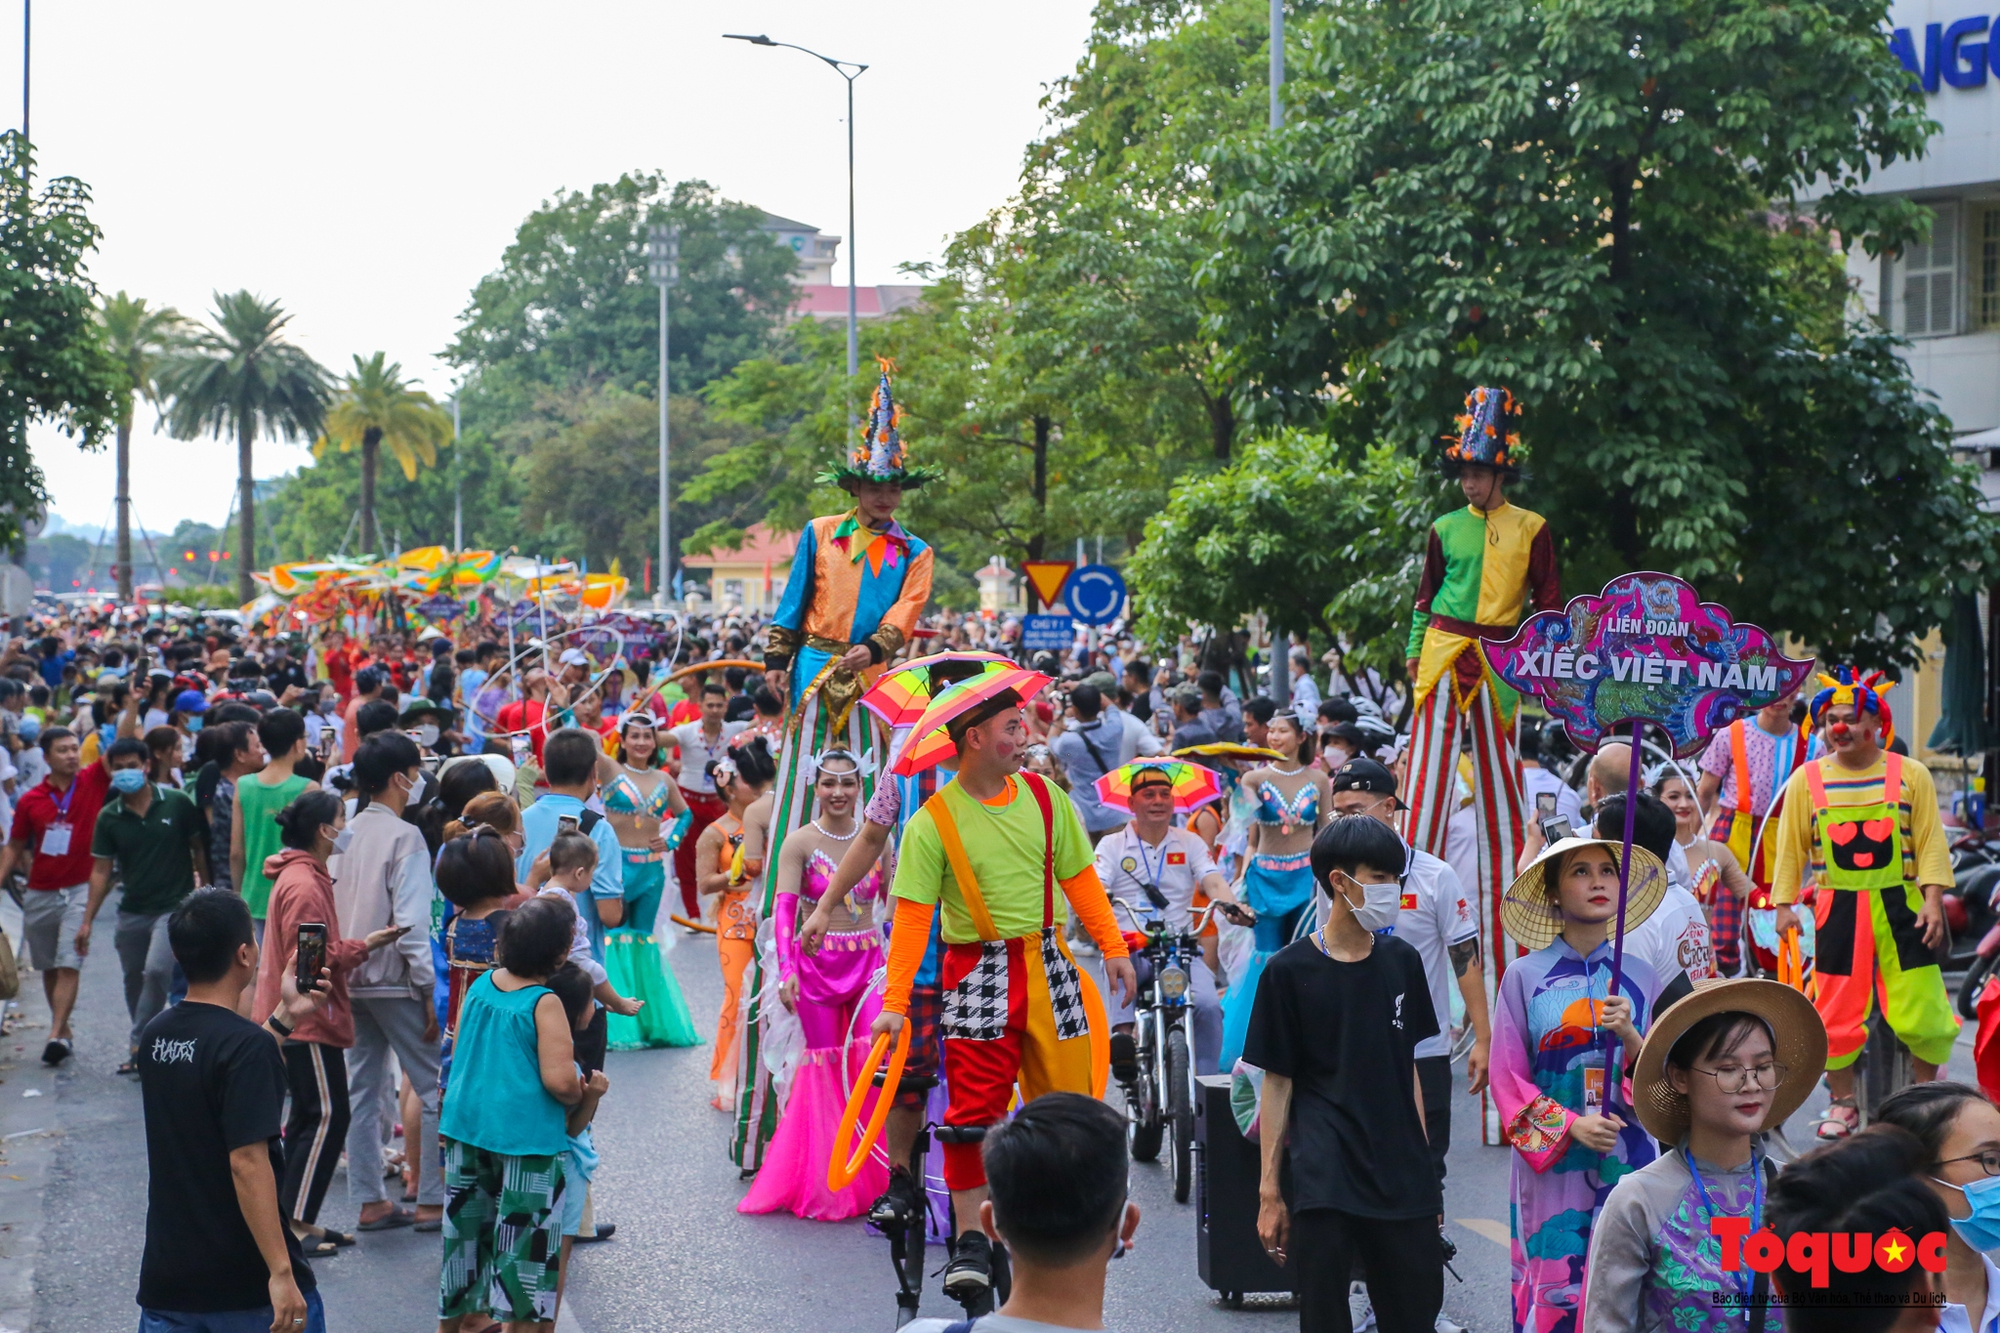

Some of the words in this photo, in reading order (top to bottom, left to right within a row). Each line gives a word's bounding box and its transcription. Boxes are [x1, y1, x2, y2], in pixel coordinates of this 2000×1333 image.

[1607, 617, 1641, 634] LIÊN
[1645, 618, 1690, 637] ĐOÀN
[1516, 645, 1599, 680] XIẾC
[1610, 652, 1687, 691] VIỆT
[1698, 662, 1778, 691] NAM
